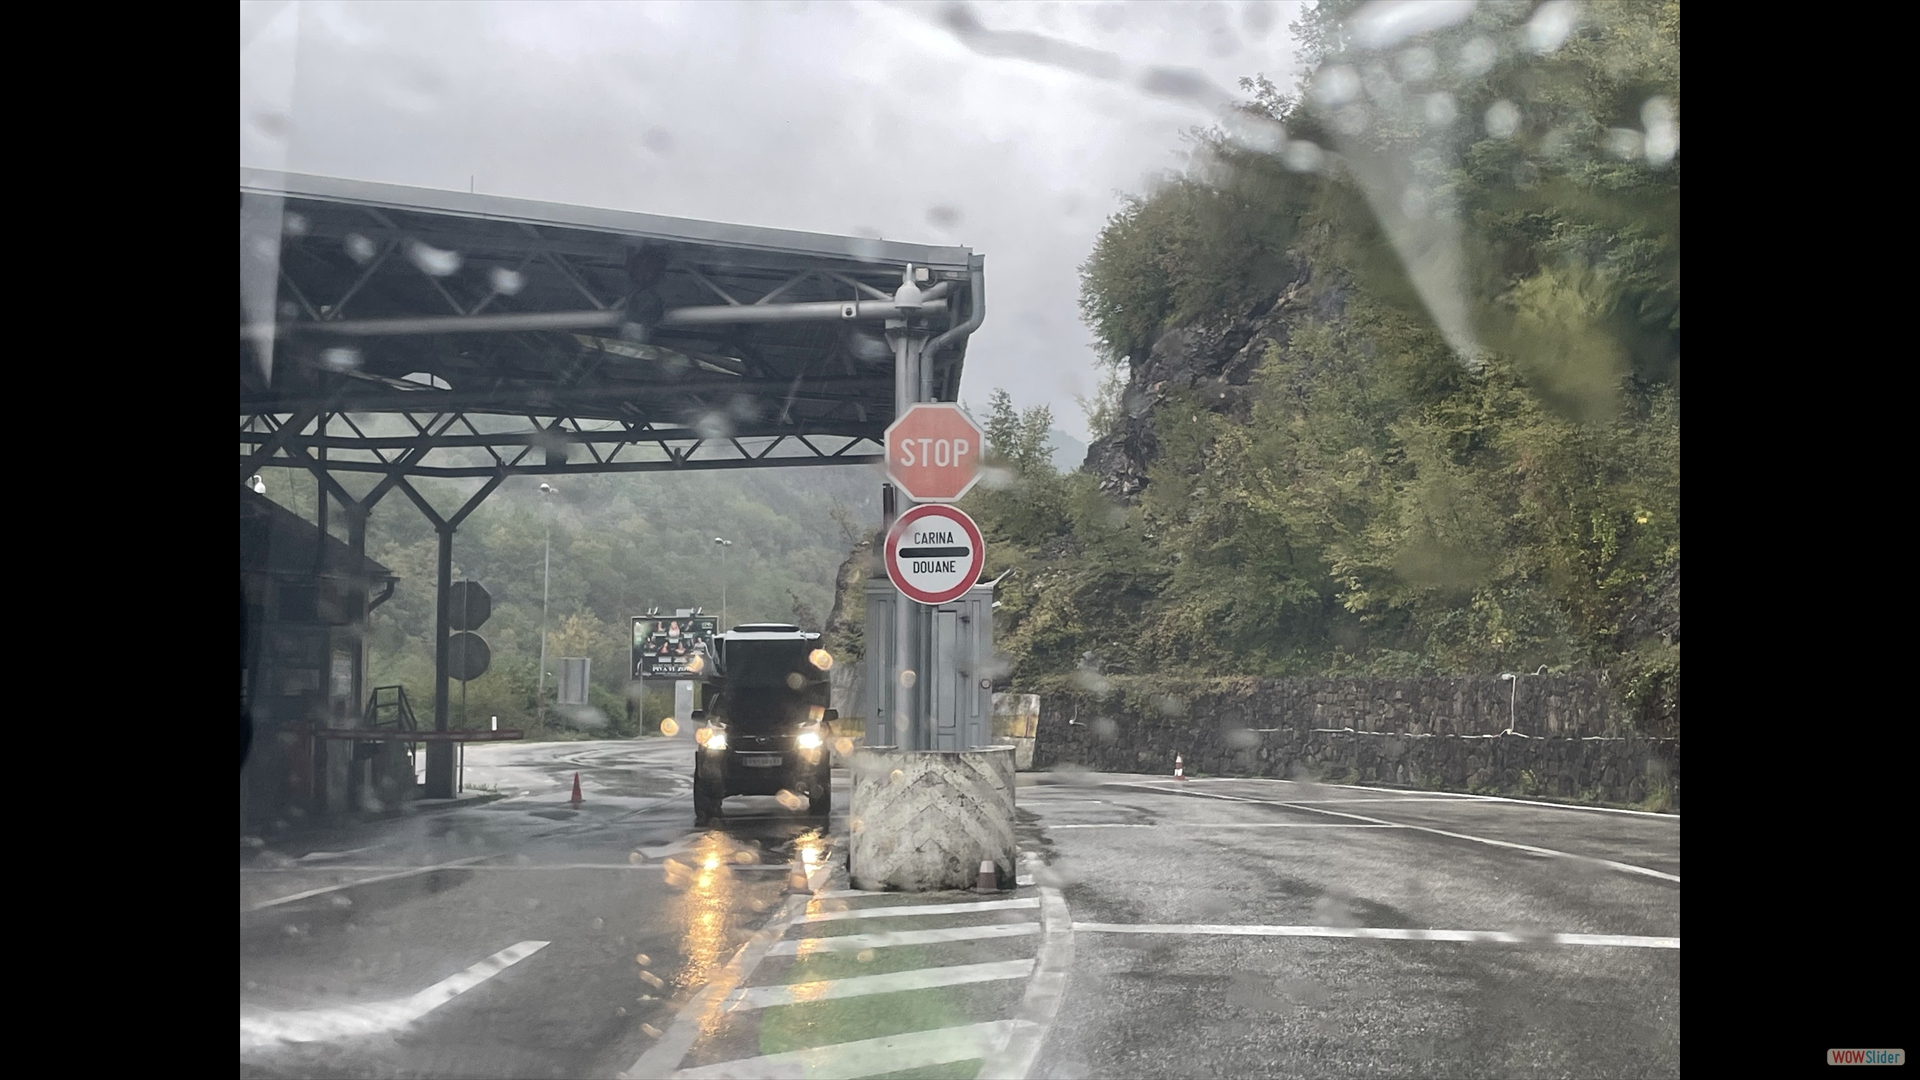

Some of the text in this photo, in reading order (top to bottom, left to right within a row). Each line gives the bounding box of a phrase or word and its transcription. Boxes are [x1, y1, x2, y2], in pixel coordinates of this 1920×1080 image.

[901, 438, 969, 467] STOP
[914, 532, 954, 544] CARINA
[913, 561, 956, 573] DOUANE
